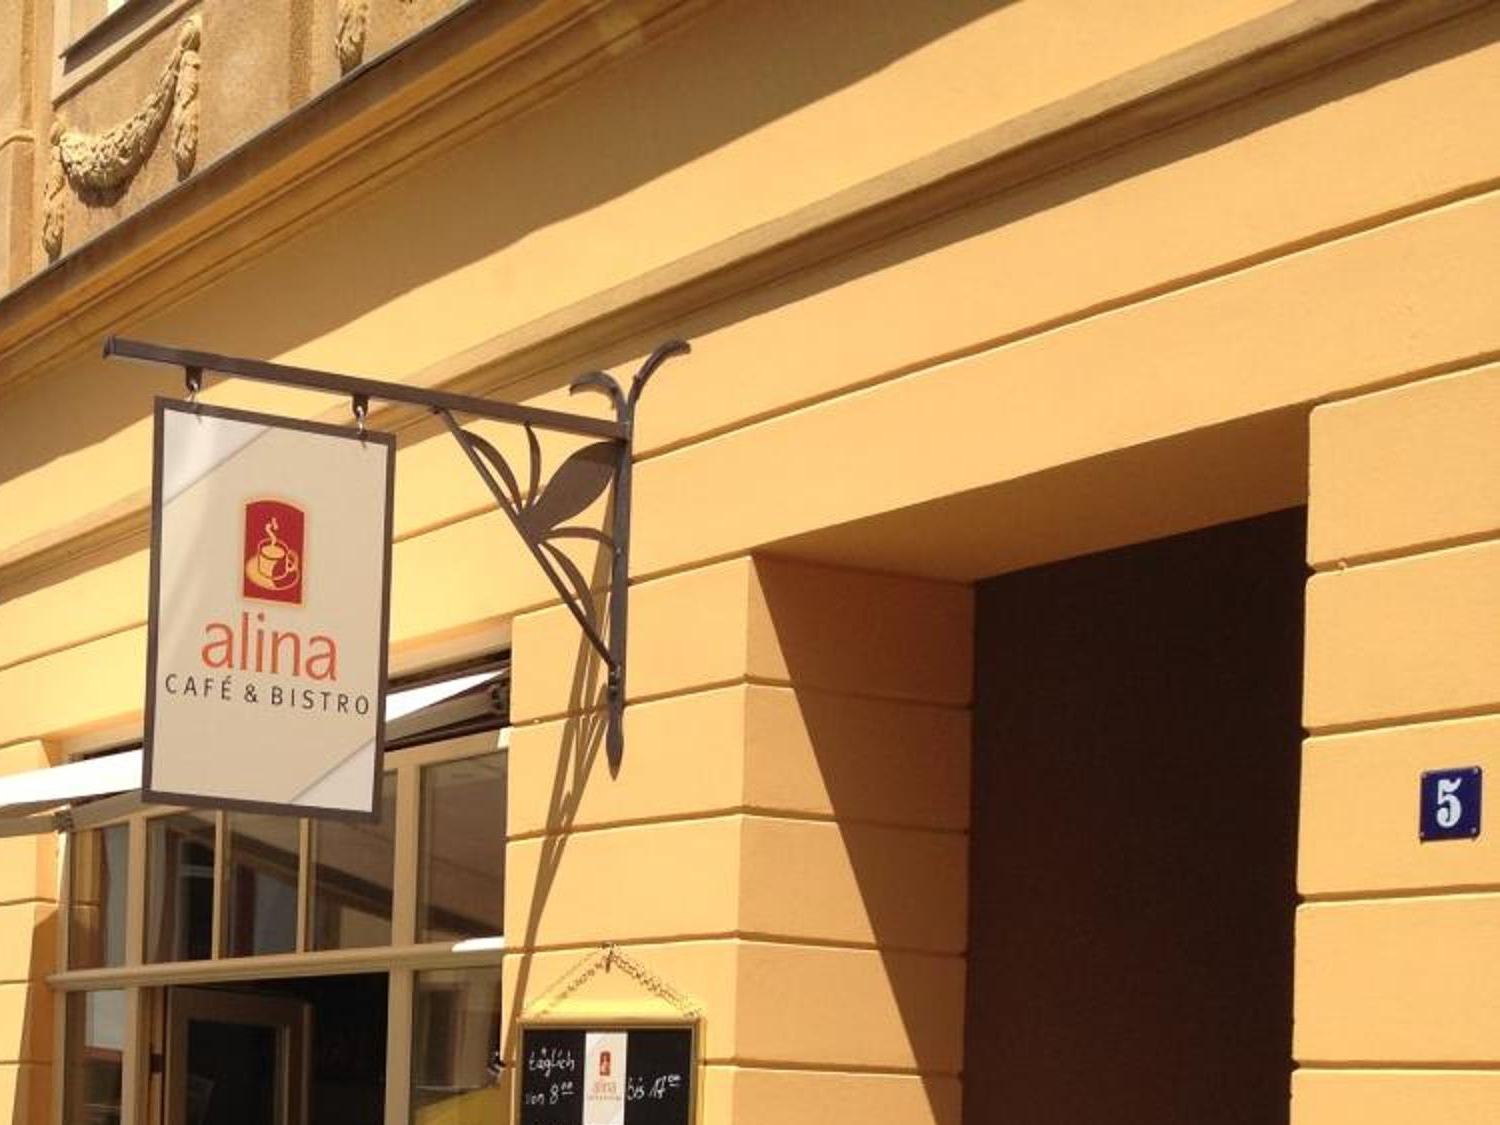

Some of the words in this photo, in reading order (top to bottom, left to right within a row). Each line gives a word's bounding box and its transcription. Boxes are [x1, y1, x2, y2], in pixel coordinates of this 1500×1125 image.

[201, 612, 338, 682] alina
[164, 673, 233, 701] CAFÉ
[243, 684, 259, 703] &
[270, 686, 371, 716] BISTRO
[1436, 777, 1462, 829] 5
